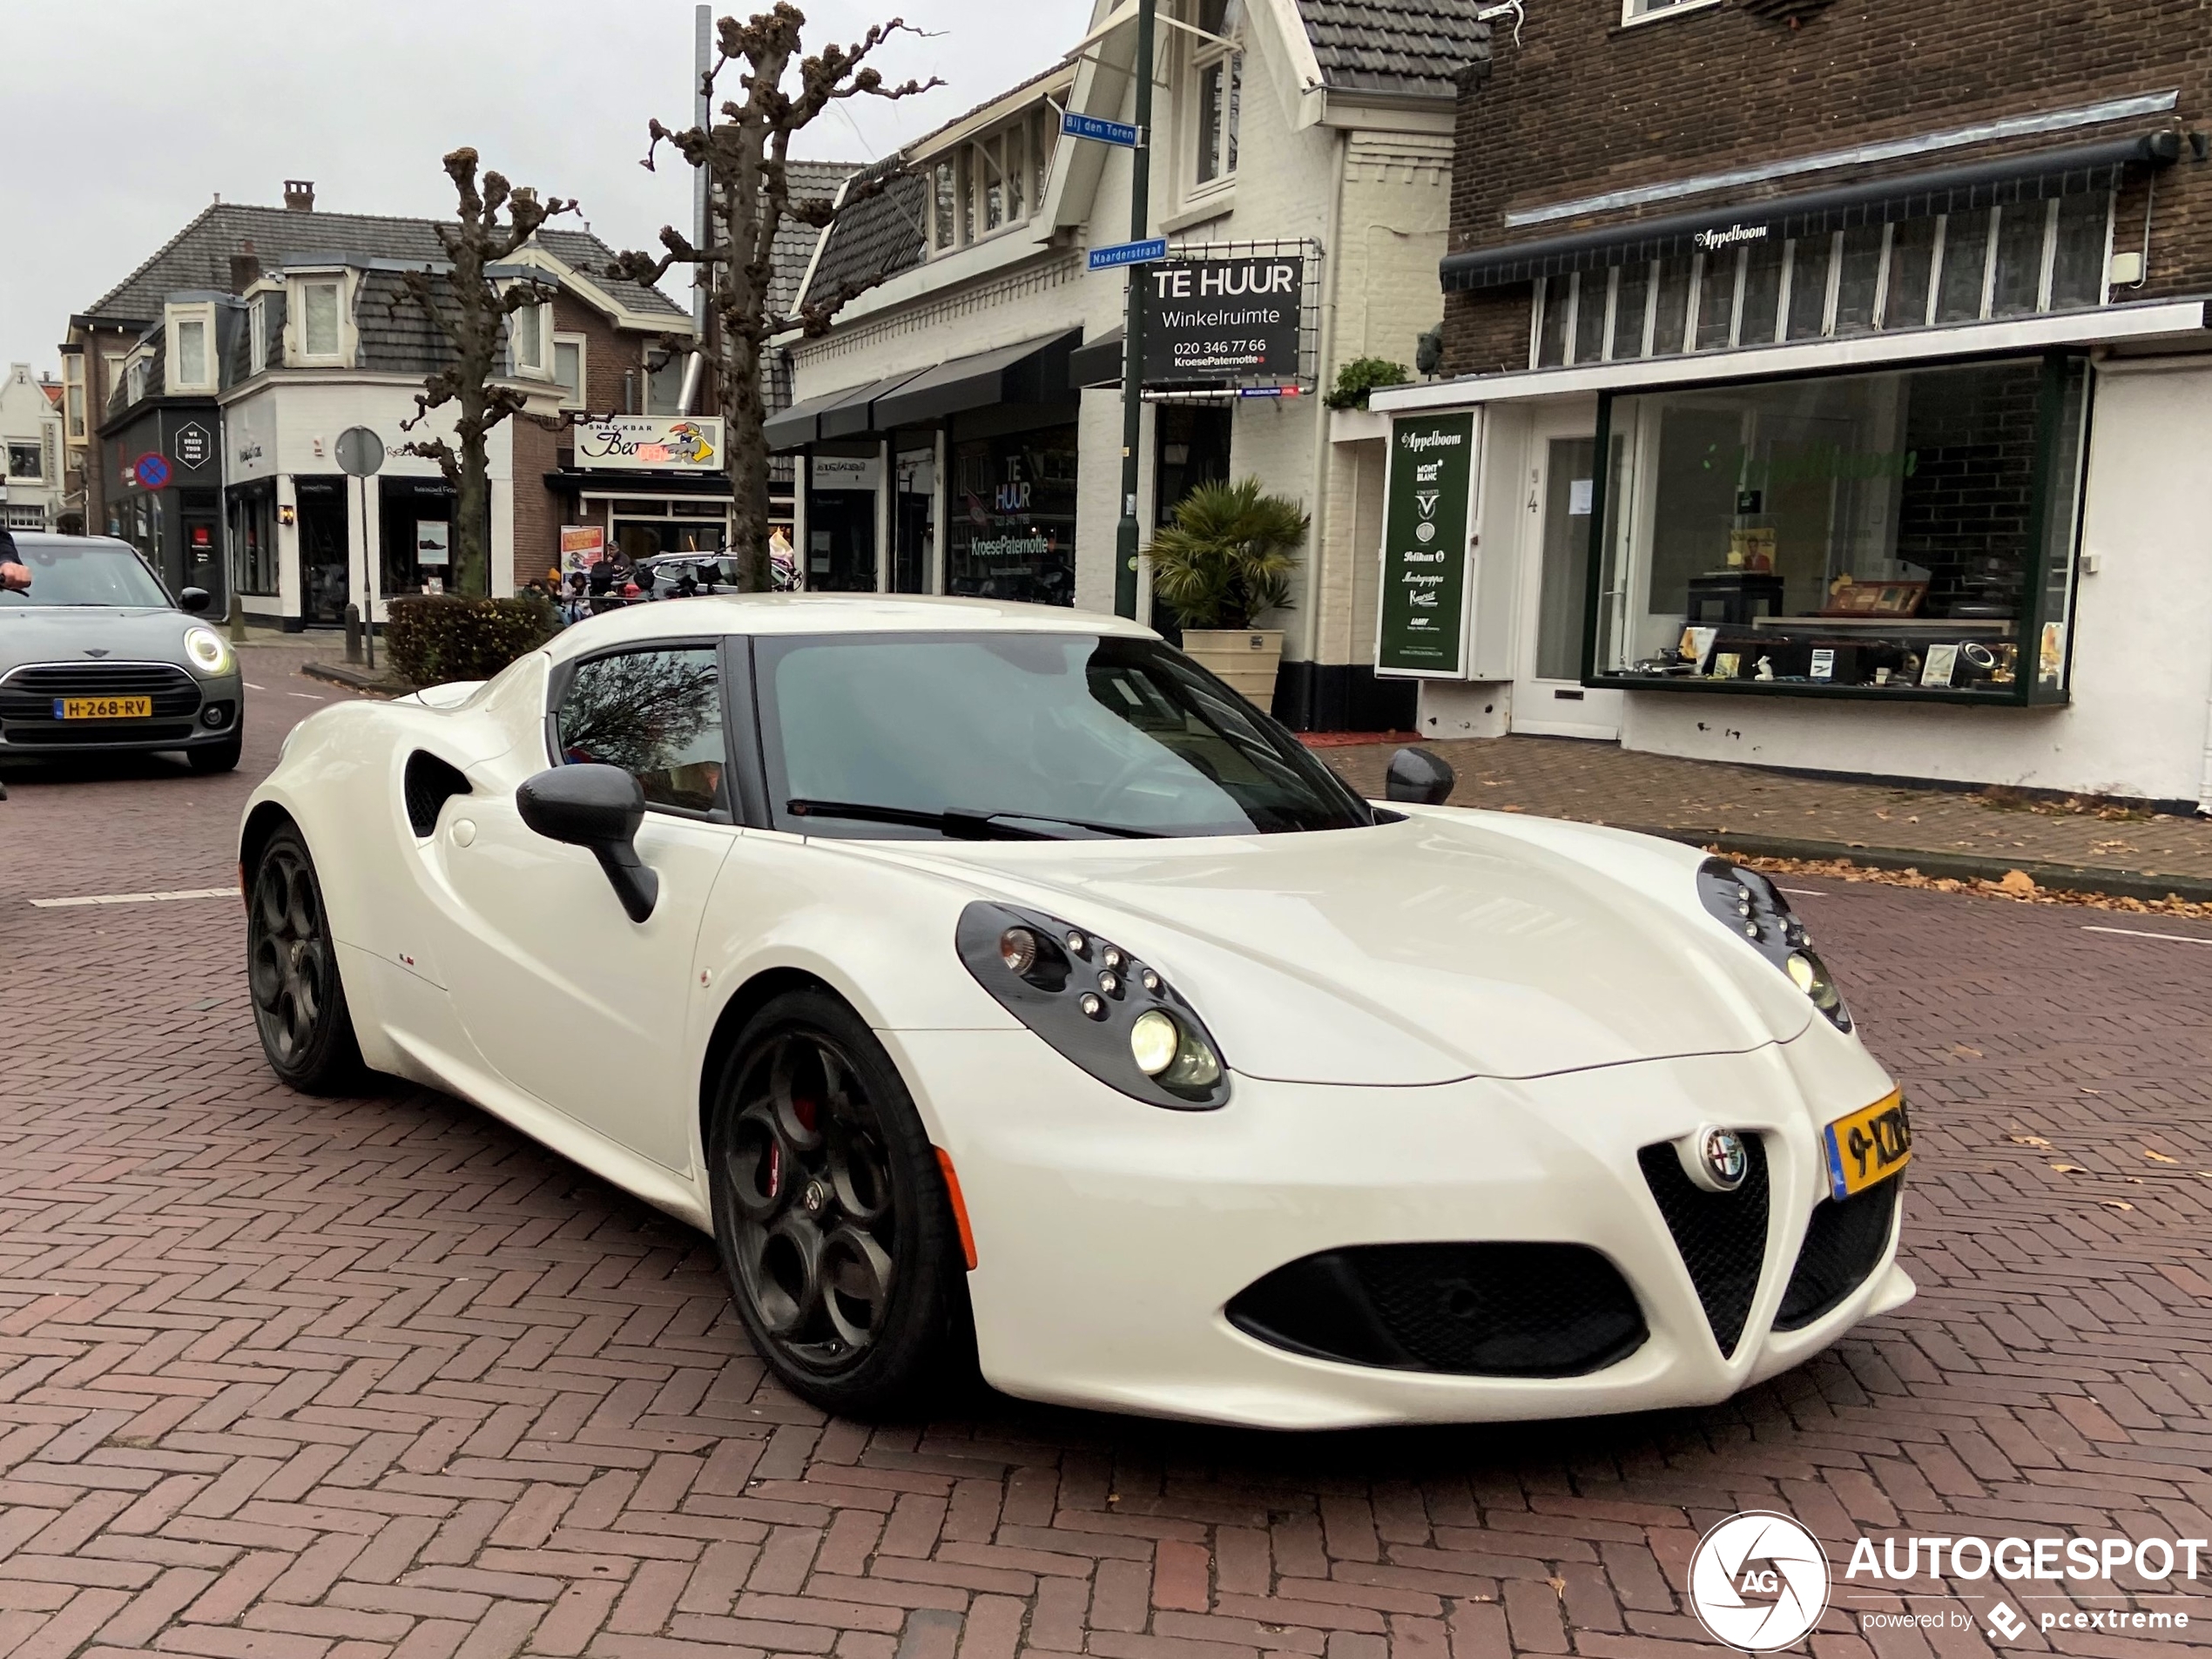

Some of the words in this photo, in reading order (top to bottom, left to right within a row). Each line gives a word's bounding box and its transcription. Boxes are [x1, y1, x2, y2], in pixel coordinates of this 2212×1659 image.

[1066, 116, 1081, 132] Bij
[1084, 119, 1102, 133] den
[1106, 124, 1133, 139] Toren
[1695, 224, 1767, 250] Appelboom
[1093, 244, 1162, 265] Naarderstraat
[1152, 270, 1191, 299] TE
[1200, 265, 1293, 296] HUUR
[1162, 308, 1280, 328] Winkelruimte
[1174, 342, 1200, 355] 020
[1203, 341, 1228, 354] 346
[1231, 340, 1246, 353] 77
[1248, 339, 1266, 352] 66
[1174, 354, 1258, 367] KroesePaternotte
[1400, 430, 1461, 452] Appelboom
[1006, 455, 1022, 481] TE
[995, 482, 1031, 509] HUUR
[1527, 489, 1537, 513] 4
[69, 700, 145, 716] H-268-RV
